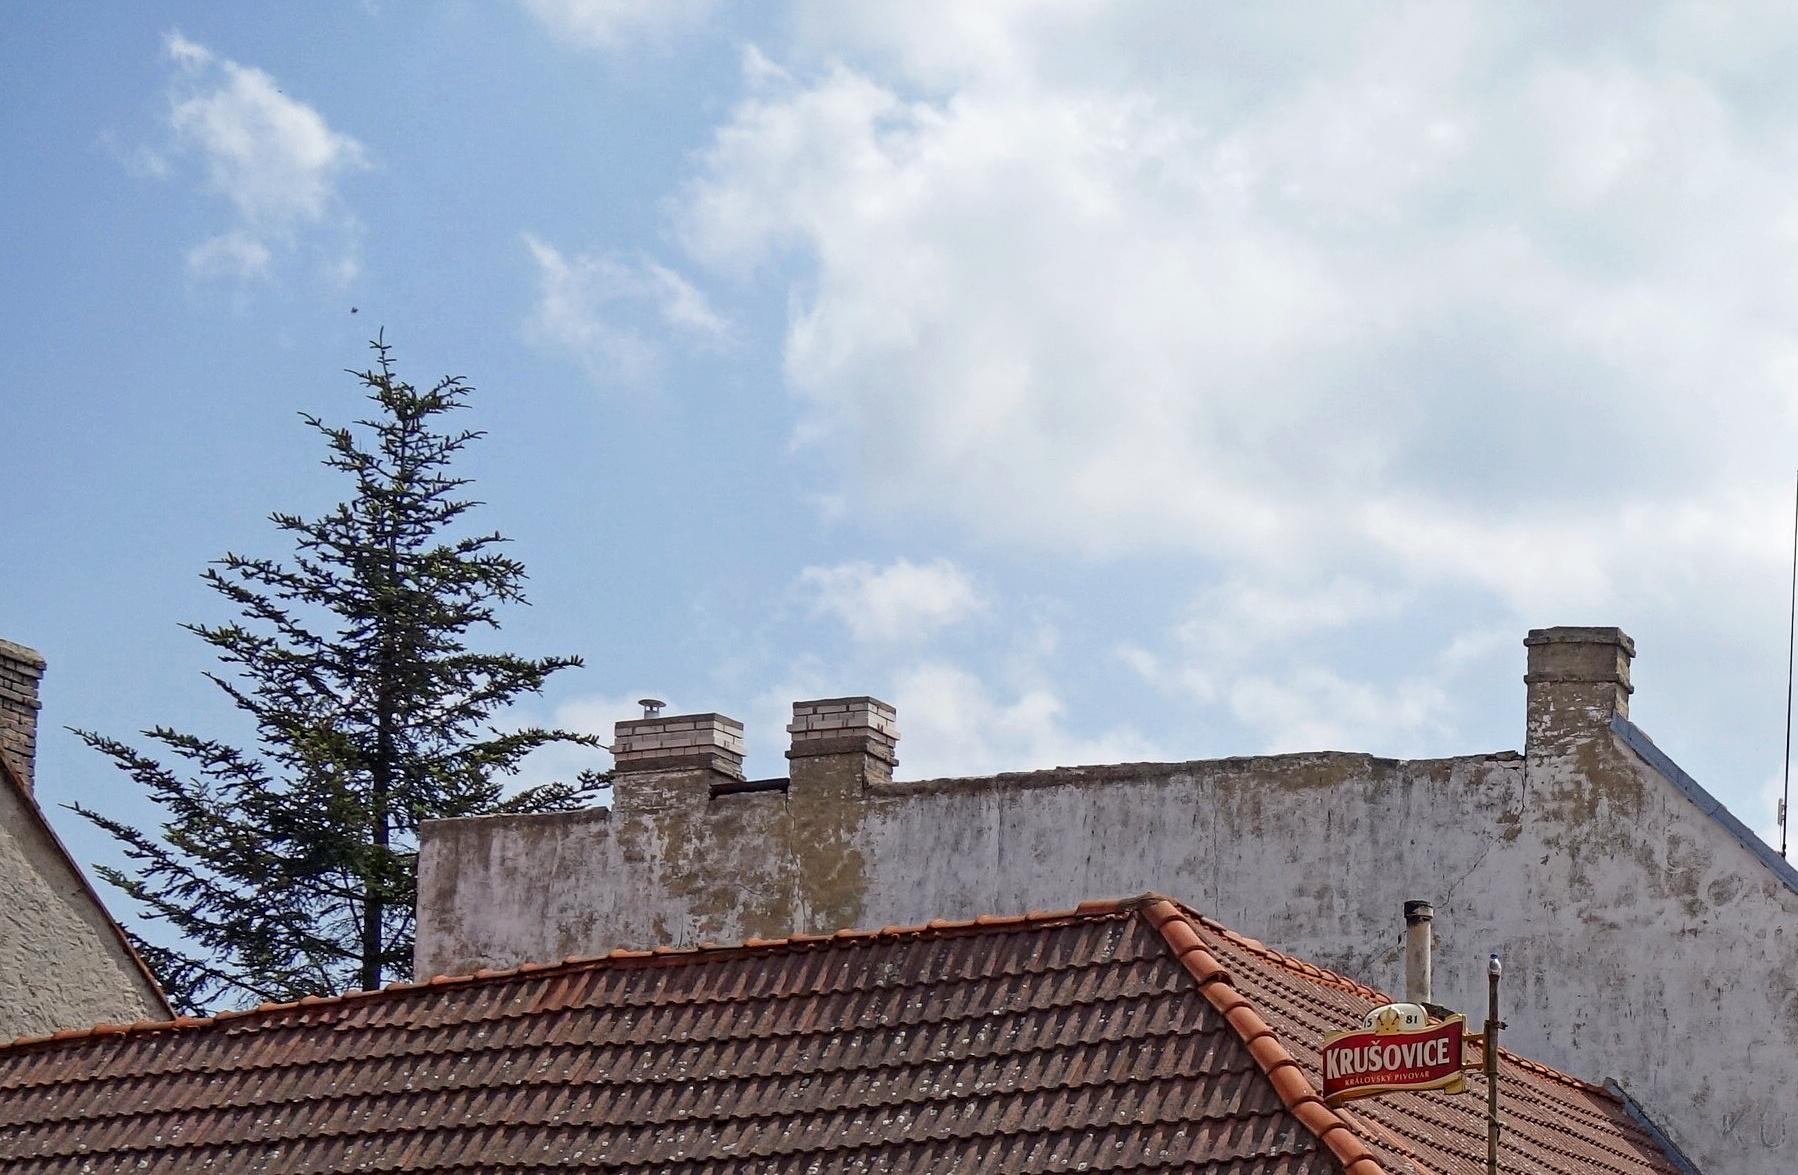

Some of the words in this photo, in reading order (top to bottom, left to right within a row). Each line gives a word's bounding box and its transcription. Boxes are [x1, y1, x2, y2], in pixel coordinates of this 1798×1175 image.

[1405, 1014, 1418, 1024] 81
[1326, 1038, 1450, 1080] KRUŠOVICE
[1344, 1073, 1391, 1086] KRÁLOVSKÝ
[1394, 1070, 1430, 1081] PIVOVAR
